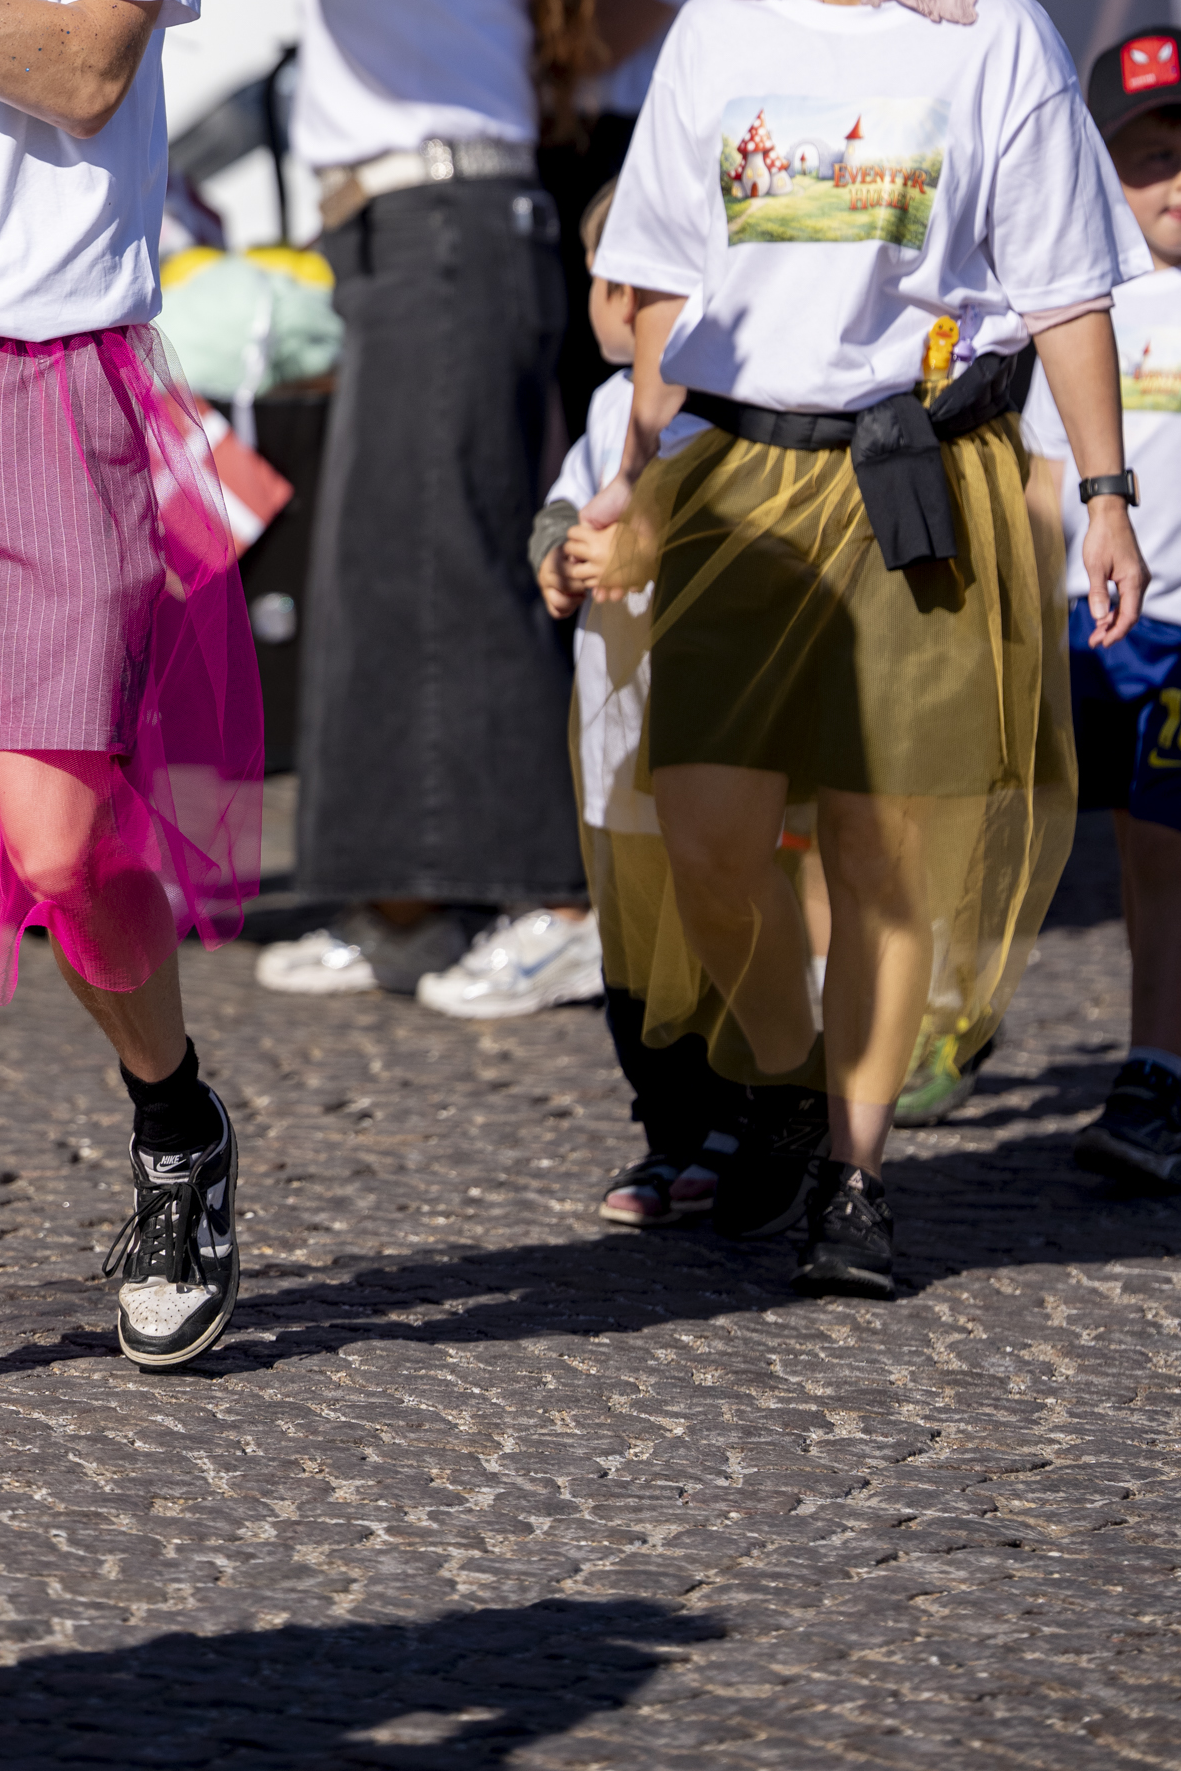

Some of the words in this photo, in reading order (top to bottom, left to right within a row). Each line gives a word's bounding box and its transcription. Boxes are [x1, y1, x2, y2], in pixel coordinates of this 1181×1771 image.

[832, 162, 926, 195] EVENTYR
[848, 188, 916, 211] HUSET
[160, 1154, 180, 1165] NIKE
